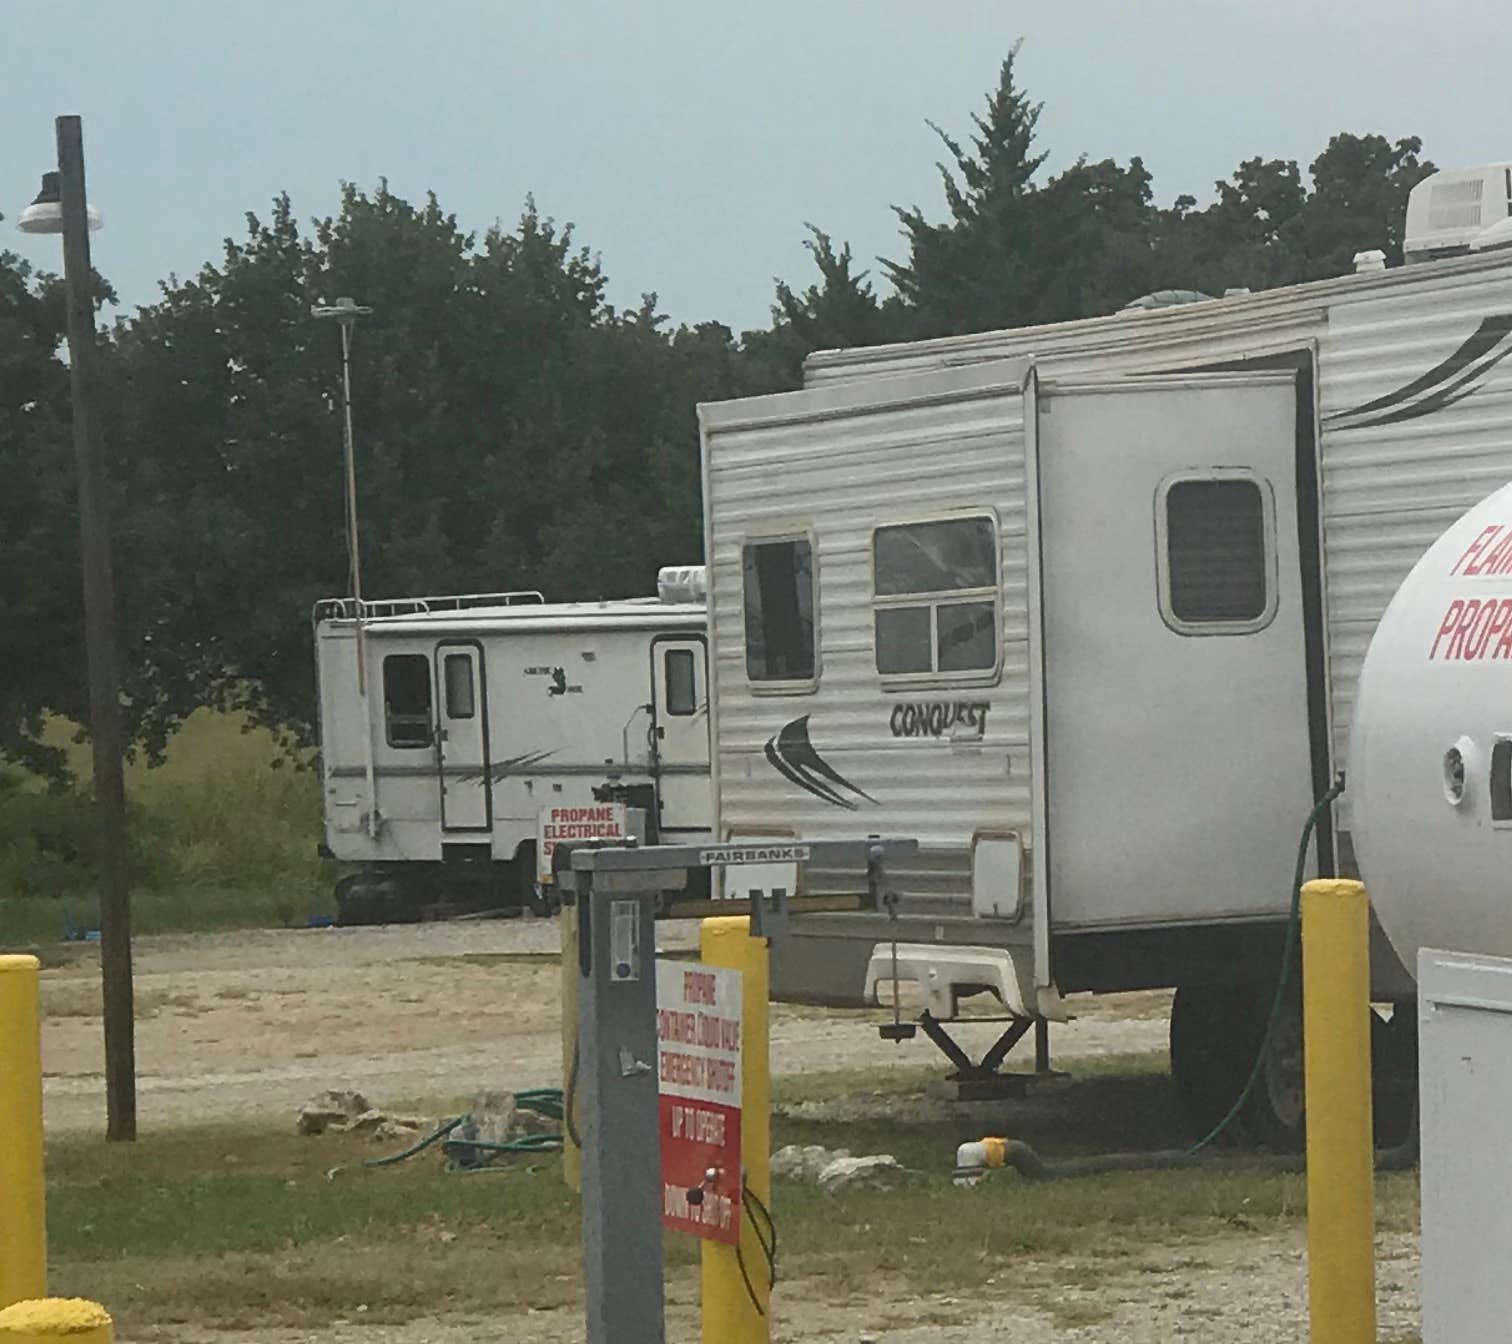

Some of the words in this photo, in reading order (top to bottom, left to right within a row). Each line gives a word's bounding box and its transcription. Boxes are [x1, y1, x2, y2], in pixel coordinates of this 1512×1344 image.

[551, 807, 615, 822] PROPANE
[544, 823, 622, 839] ELECTRICAL
[706, 849, 804, 863] FAIRBANKS
